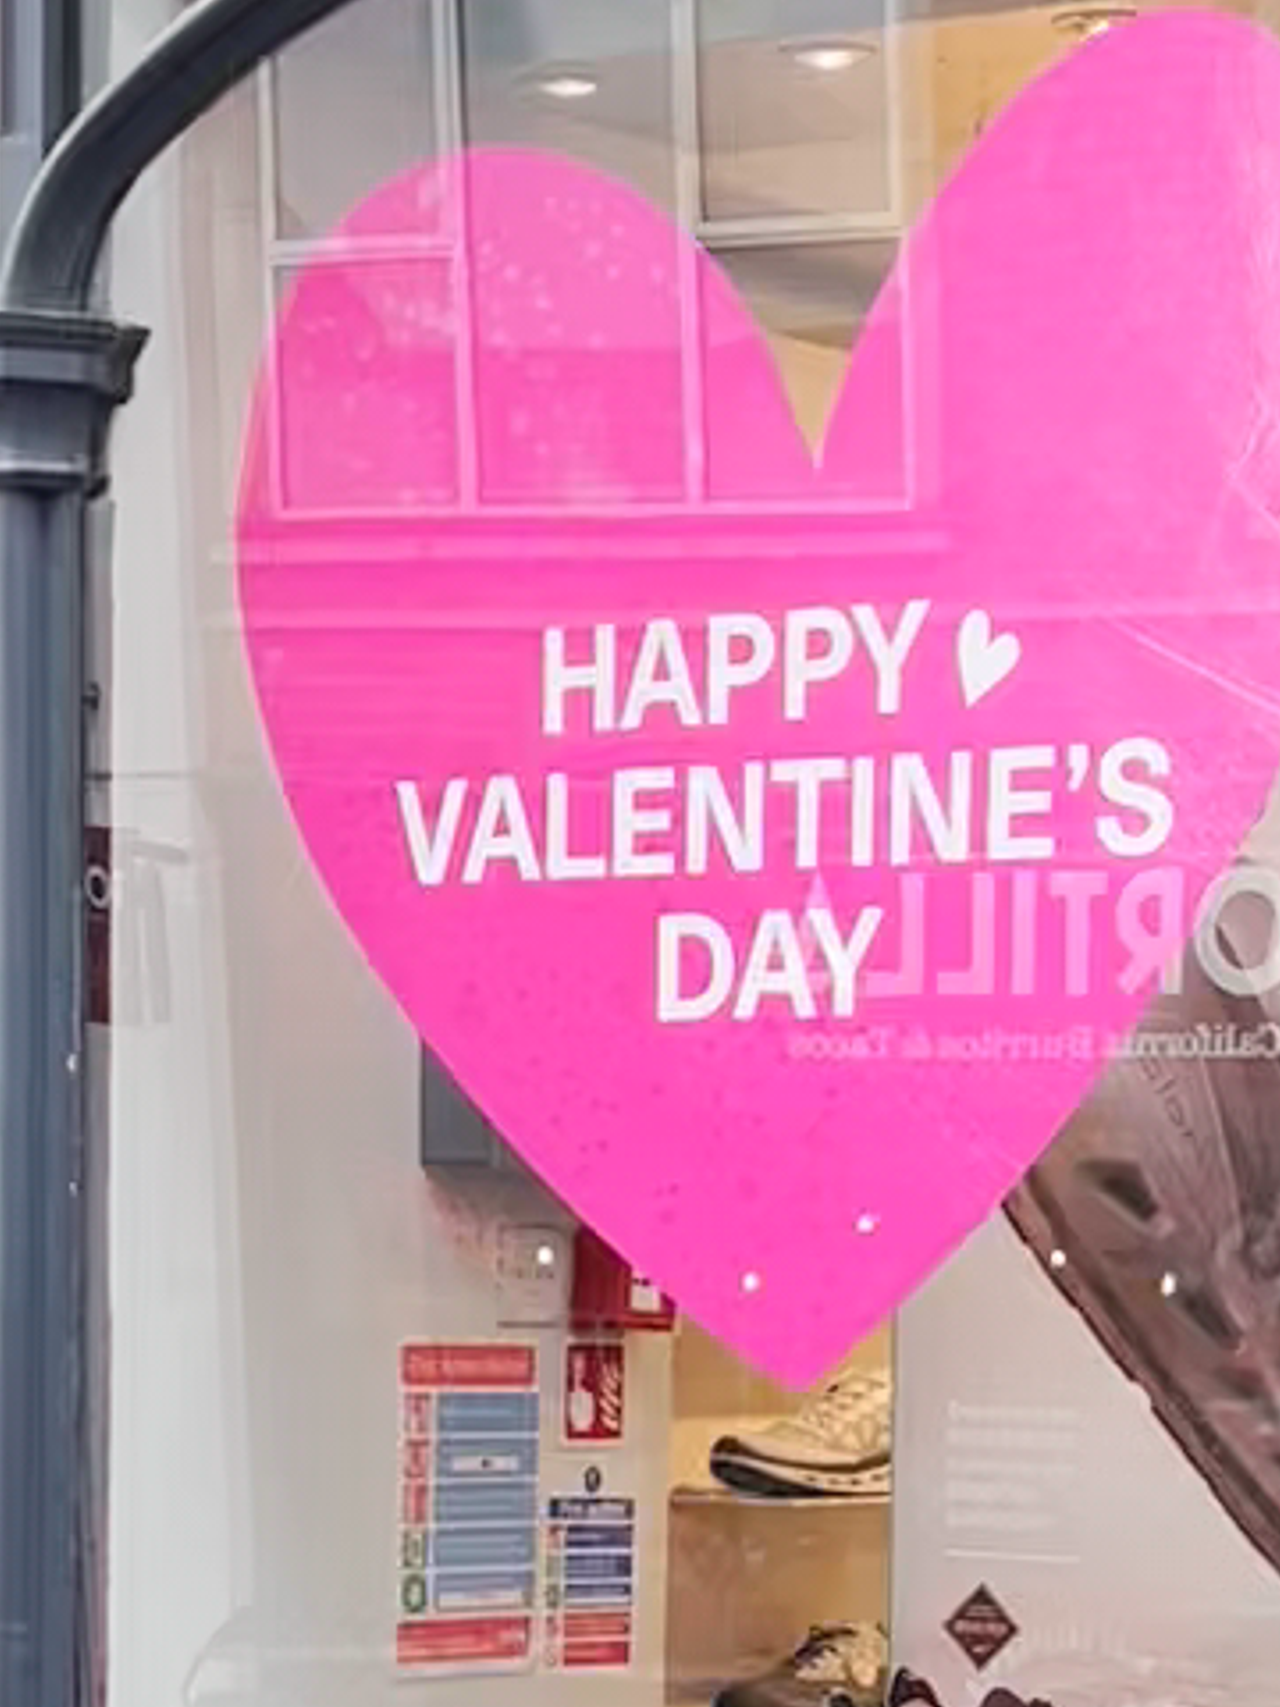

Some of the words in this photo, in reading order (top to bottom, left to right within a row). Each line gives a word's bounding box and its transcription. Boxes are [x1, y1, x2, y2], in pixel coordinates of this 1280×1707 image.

[540, 599, 931, 736] HAPPY
[395, 738, 1175, 886] VALENTINE'S
[655, 906, 884, 1024] DAY
